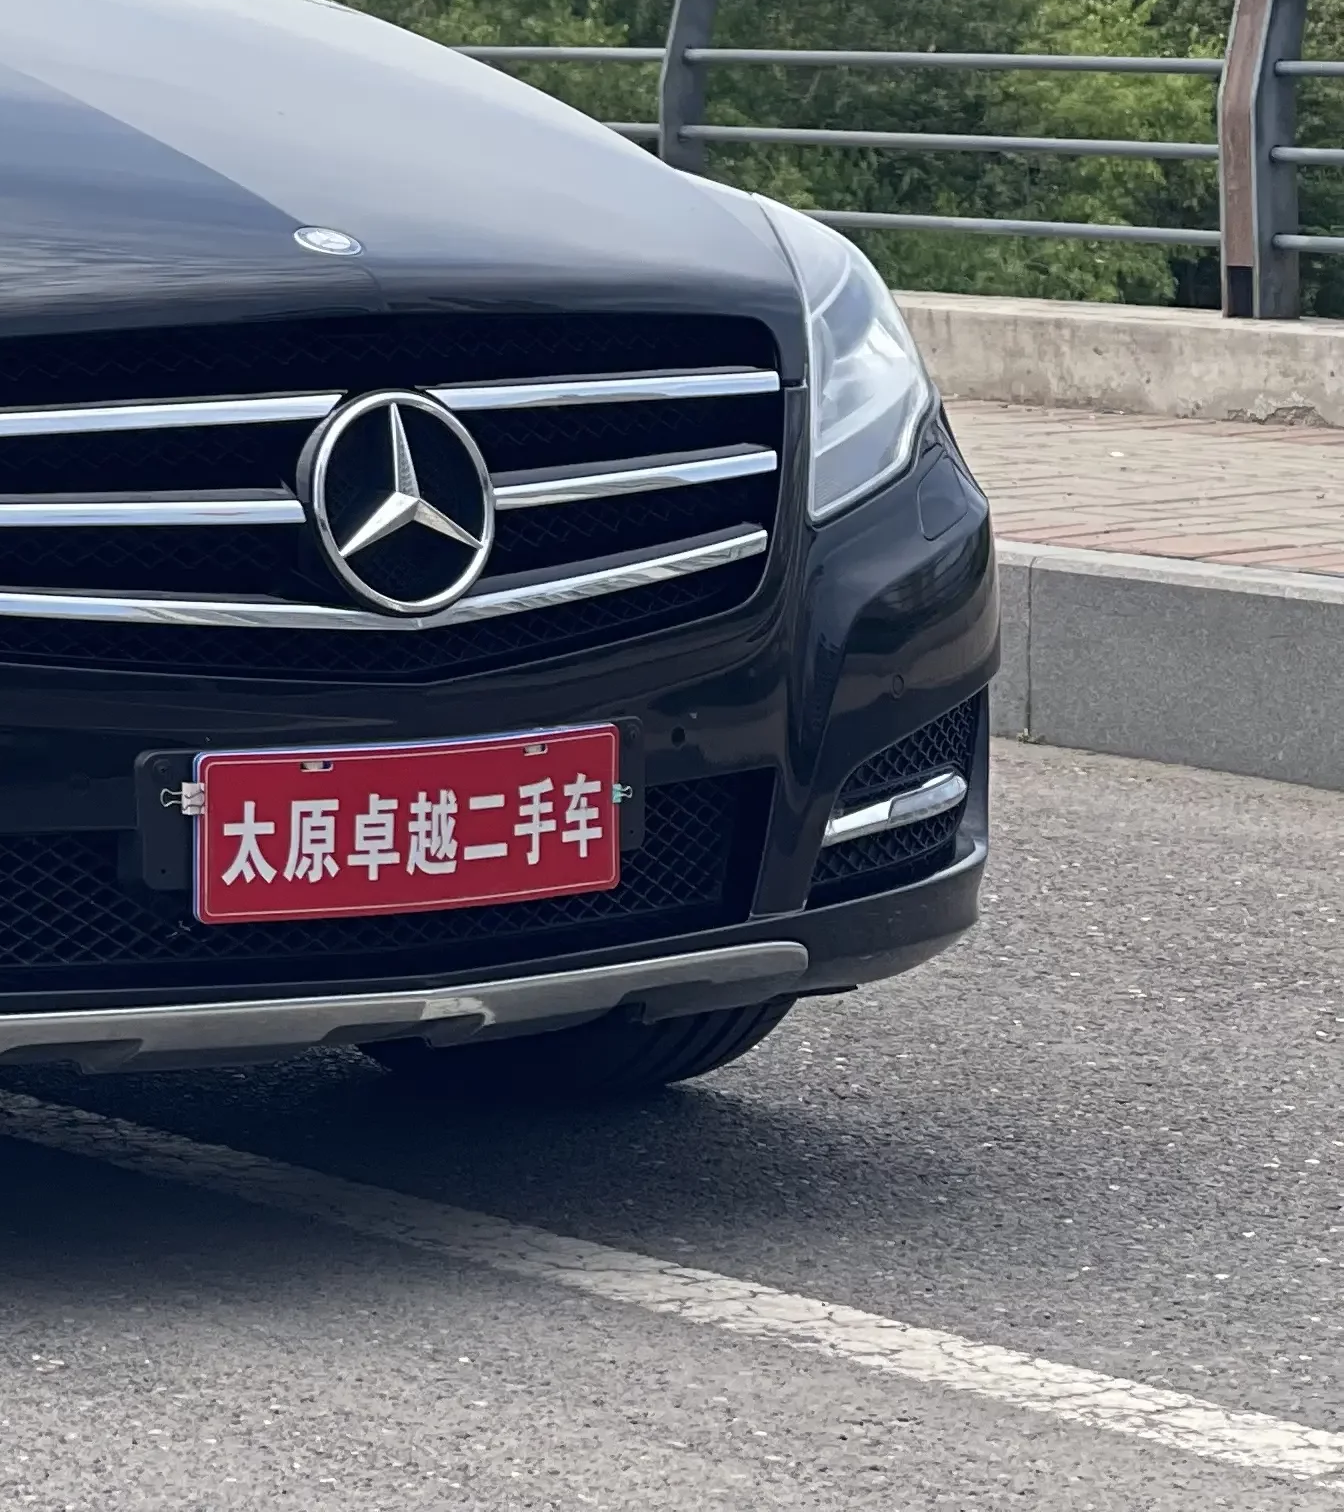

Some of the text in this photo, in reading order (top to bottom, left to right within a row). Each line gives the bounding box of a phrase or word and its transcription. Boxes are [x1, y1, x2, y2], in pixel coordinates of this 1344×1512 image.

[221, 773, 603, 886] 太原卓越二手车
